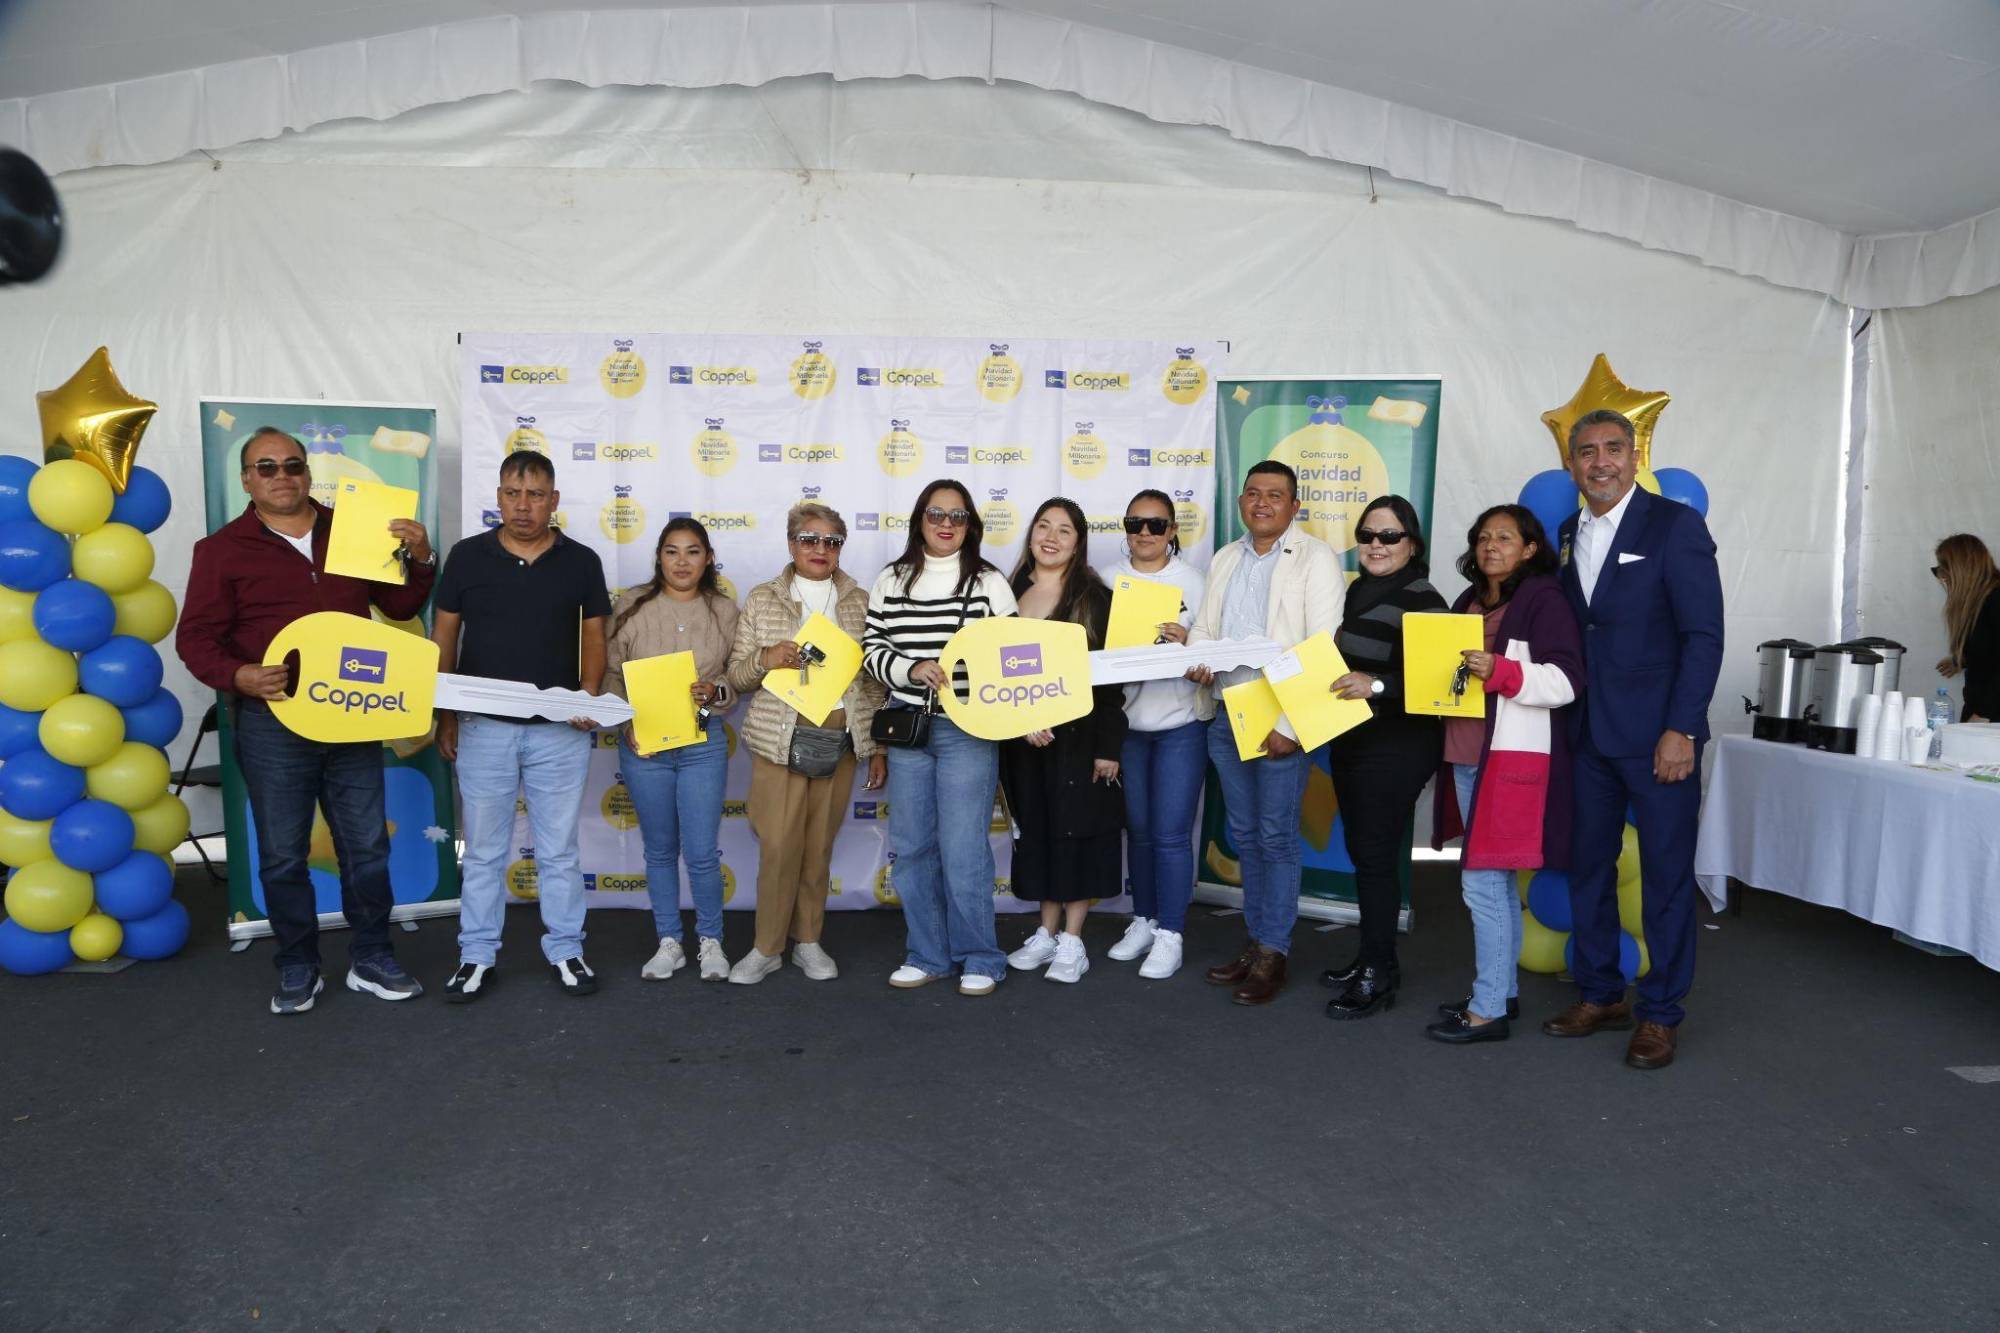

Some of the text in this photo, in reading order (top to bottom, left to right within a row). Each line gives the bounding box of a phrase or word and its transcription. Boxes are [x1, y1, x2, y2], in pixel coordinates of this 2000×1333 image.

[511, 369, 561, 384] Coppel
[700, 370, 750, 385] Coppel
[887, 371, 937, 386] Coppel
[1073, 374, 1122, 390] Coppel
[602, 447, 652, 461] Coppel
[789, 448, 839, 462] Coppel
[975, 450, 1025, 464] Coppel
[1157, 452, 1206, 466] Coppel
[1301, 450, 1349, 459] Concurso
[1297, 486, 1368, 503] illonaria
[700, 515, 749, 530] Coppel
[1314, 511, 1349, 521] Coppel
[308, 681, 408, 714] Coppel
[979, 677, 1069, 707] Coppel
[602, 876, 647, 891] Coppe
